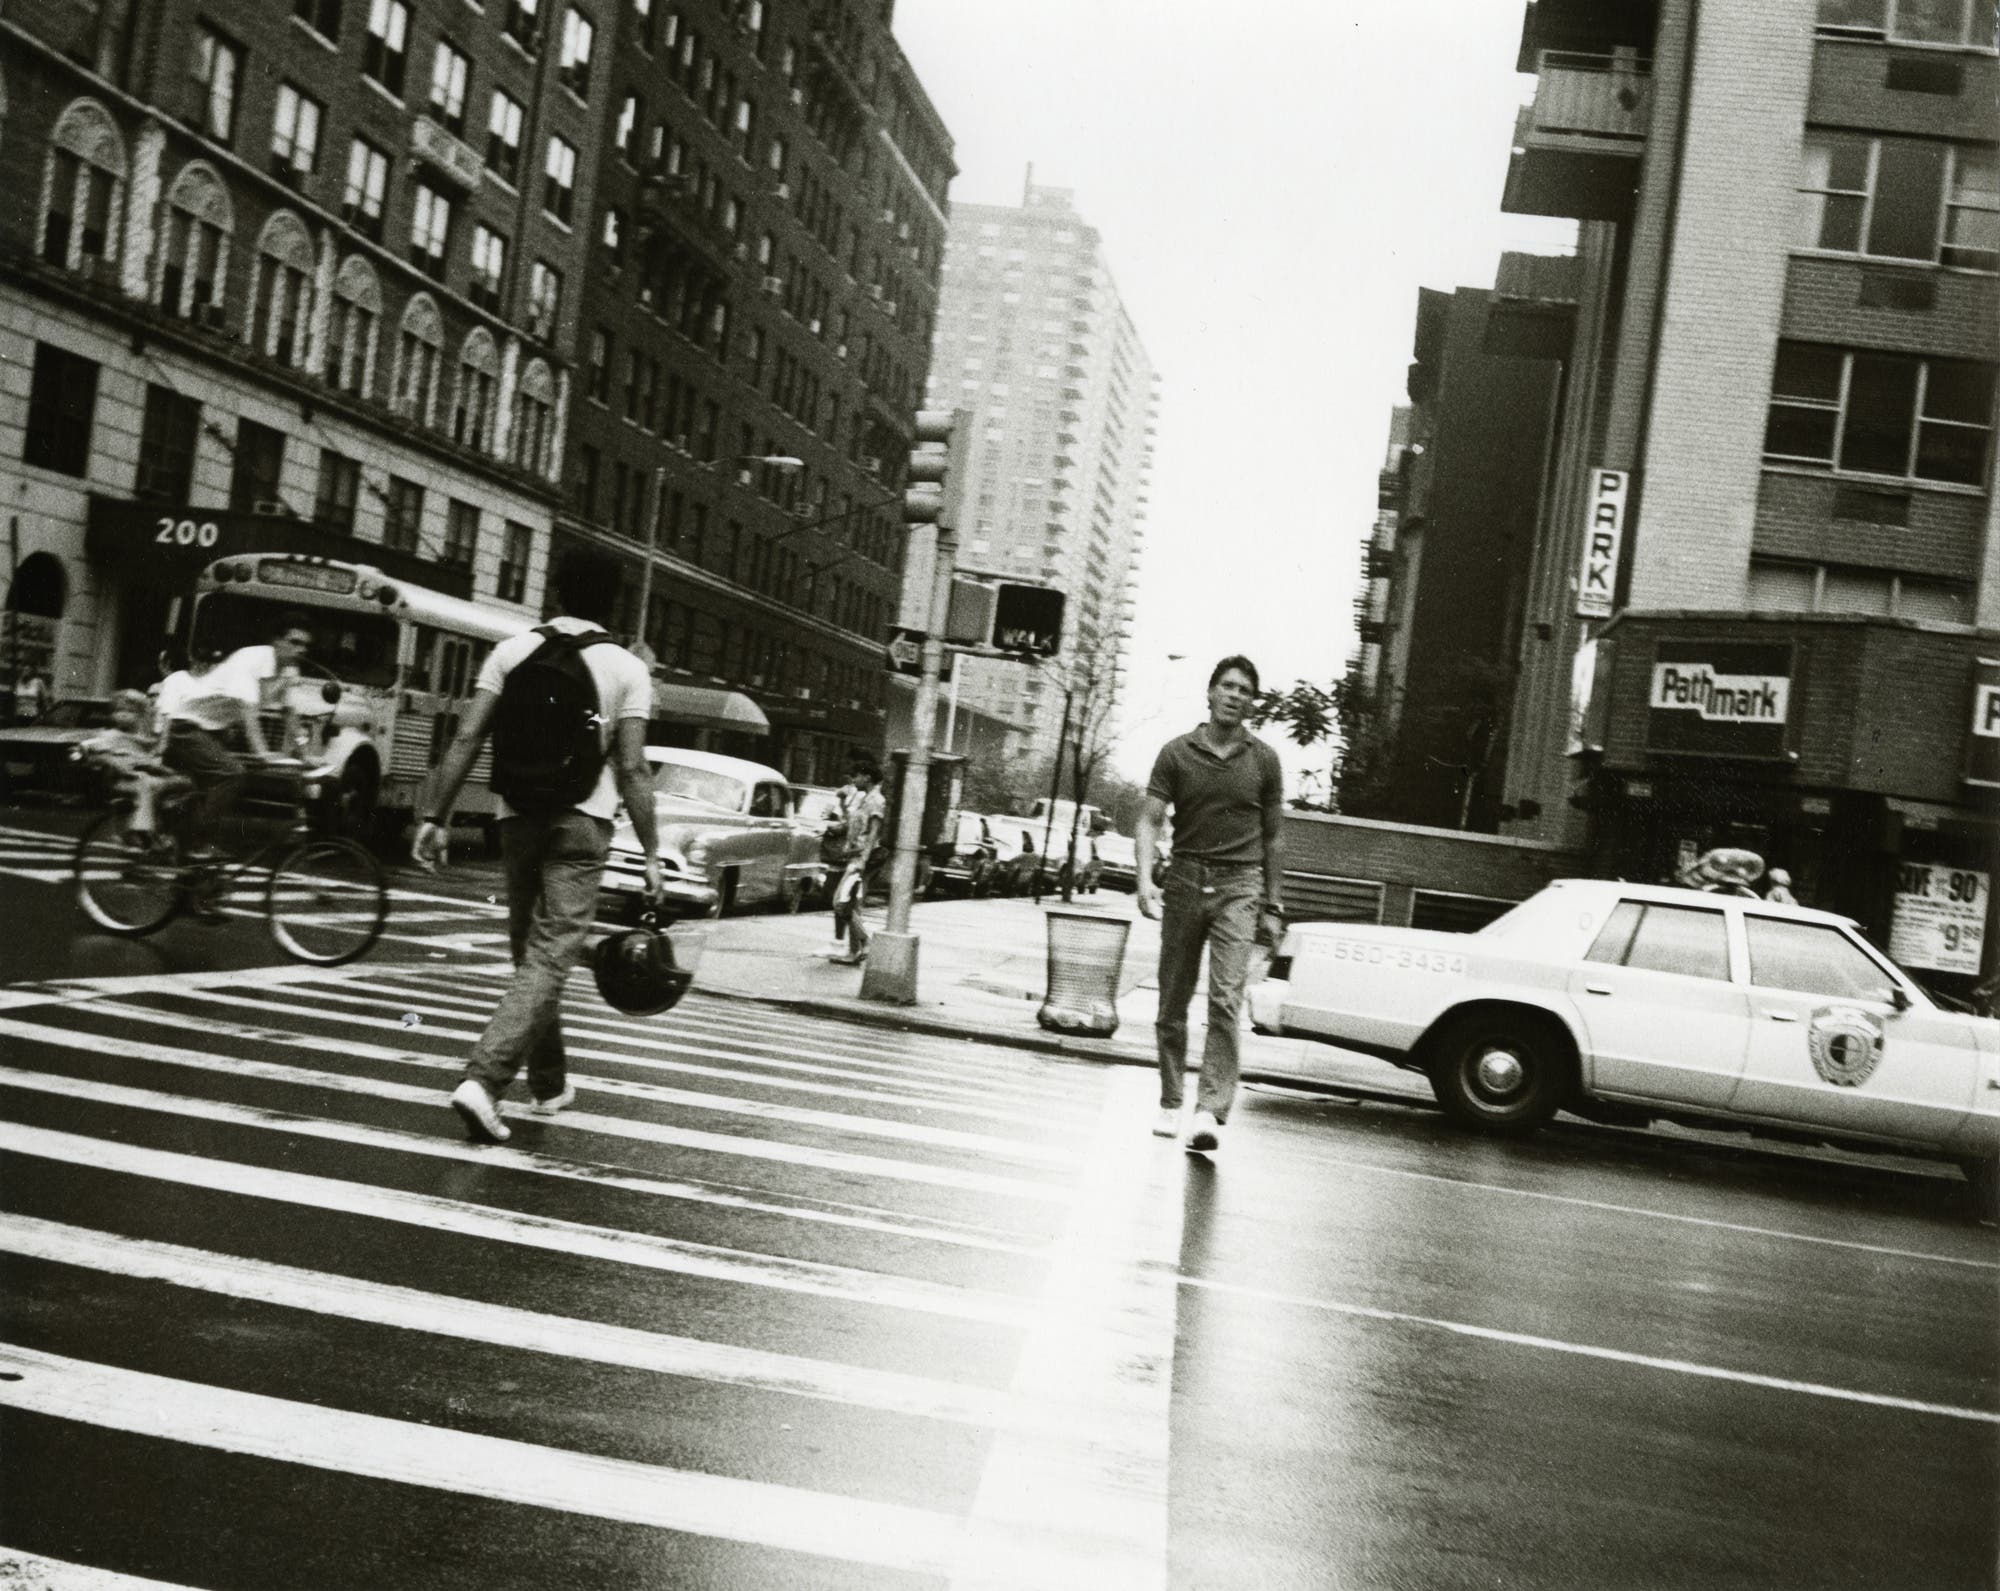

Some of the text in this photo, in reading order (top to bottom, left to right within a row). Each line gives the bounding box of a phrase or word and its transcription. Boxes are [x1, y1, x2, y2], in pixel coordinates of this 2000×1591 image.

[155, 517, 219, 547] 200
[1587, 472, 1621, 589] PARK
[1661, 667, 1778, 718] Pathmark
